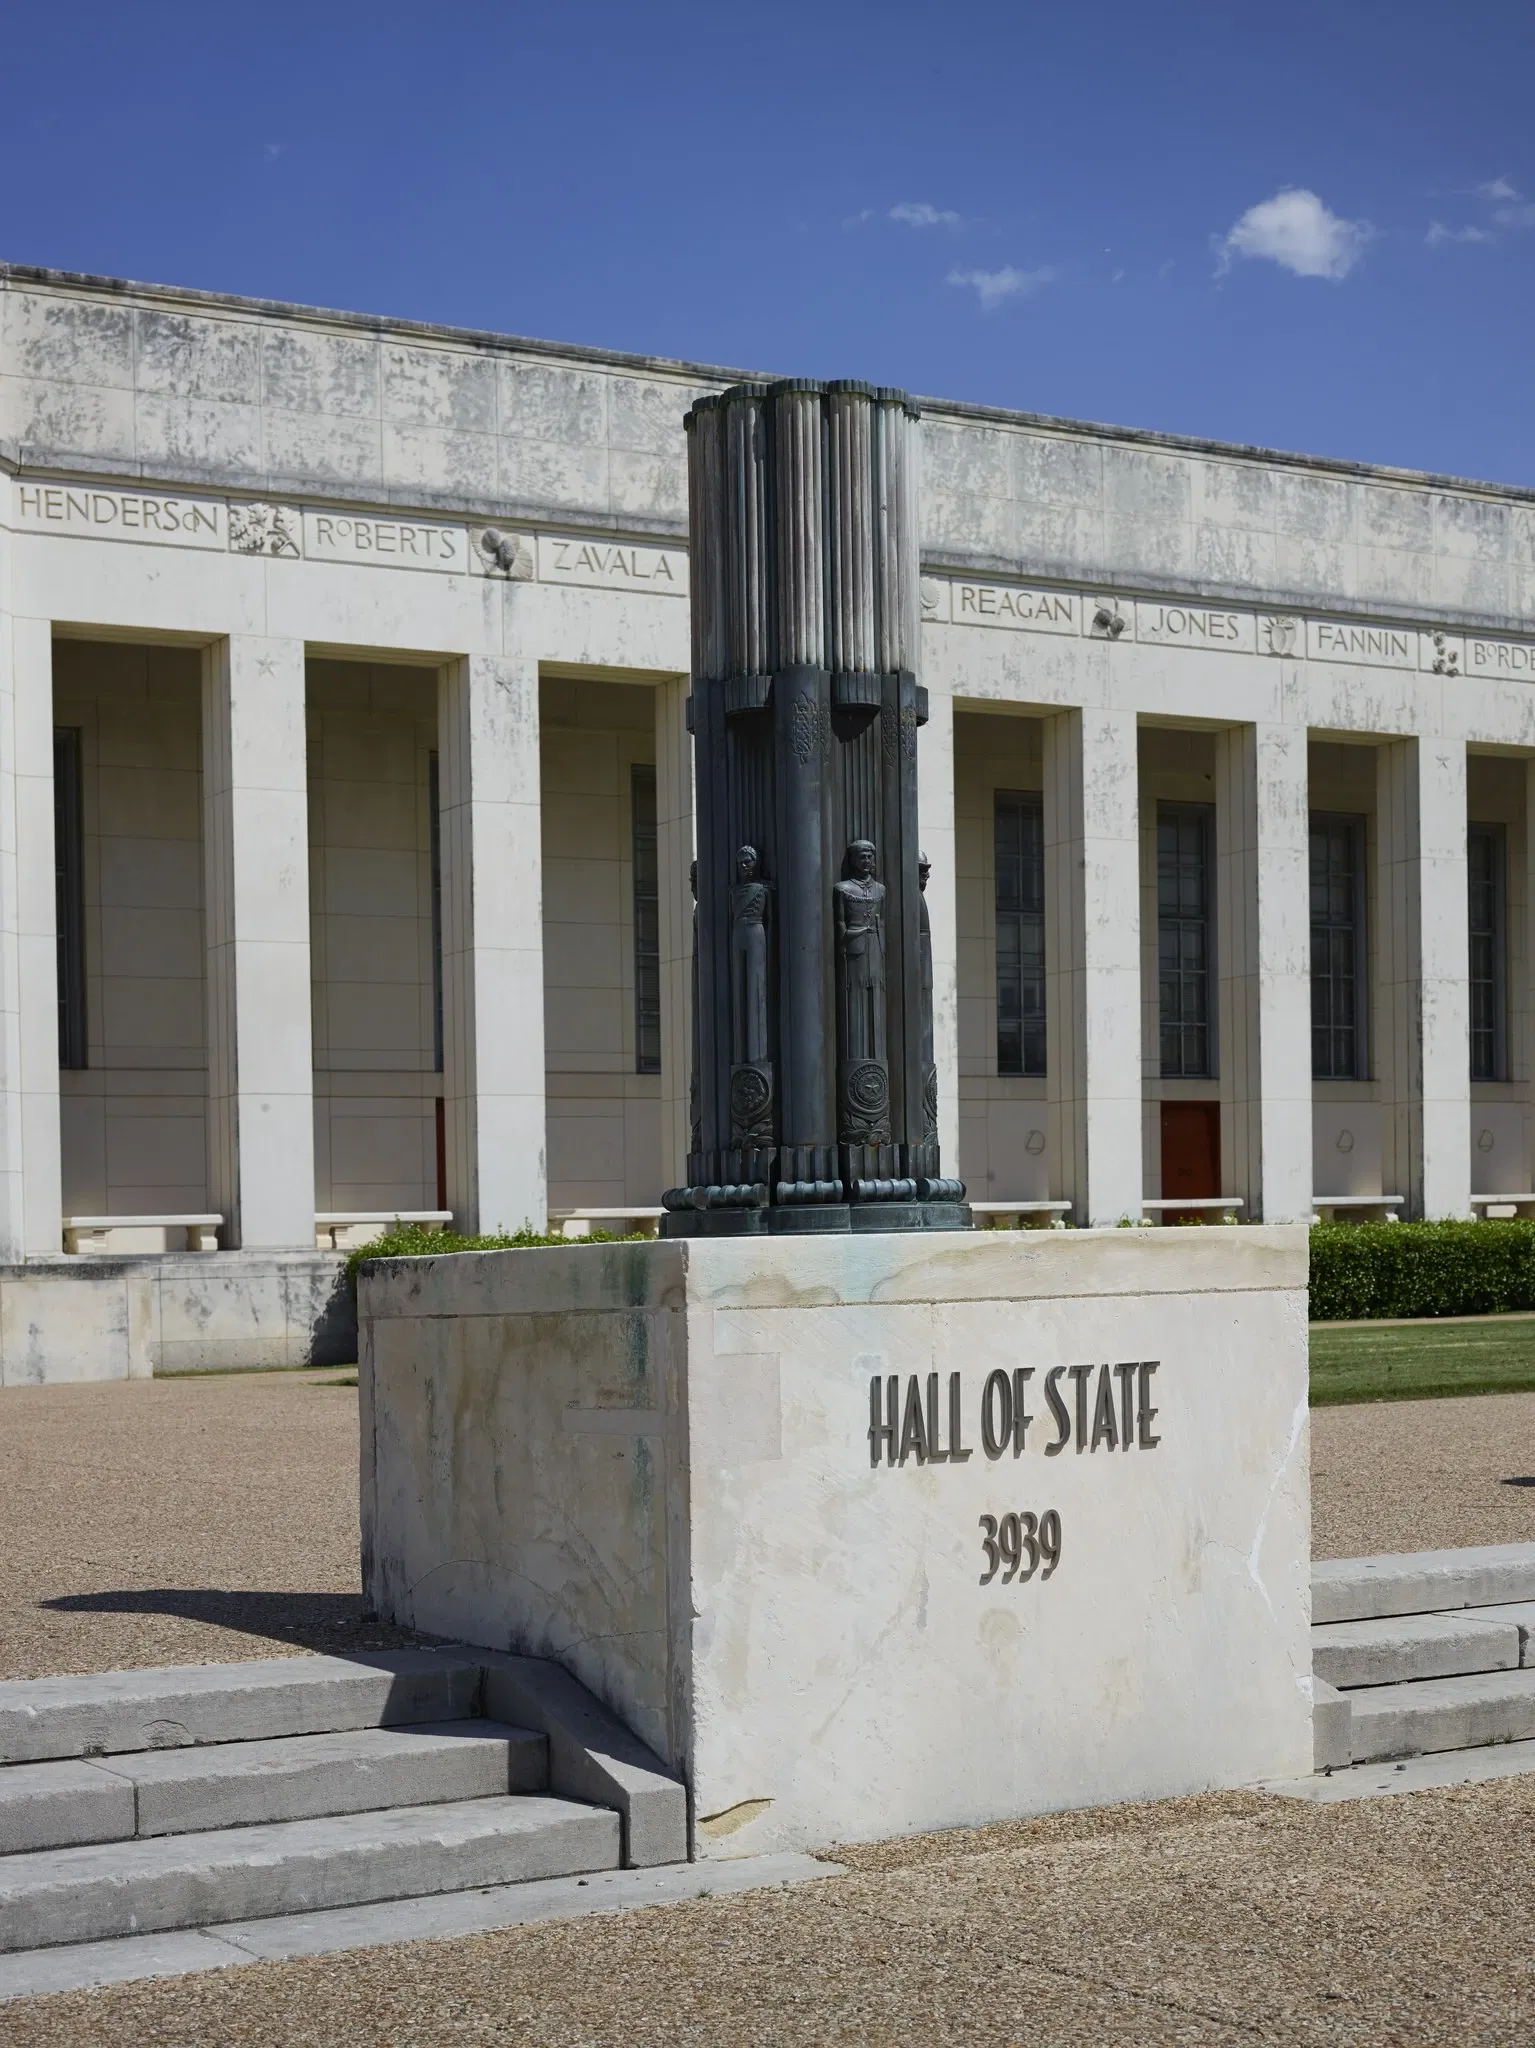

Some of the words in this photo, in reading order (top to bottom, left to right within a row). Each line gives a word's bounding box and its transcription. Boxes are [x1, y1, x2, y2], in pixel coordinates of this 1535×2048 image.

[19, 486, 218, 536] HENDERSON
[316, 517, 456, 559] ROBERTS
[551, 542, 674, 581] ZAVALA
[961, 586, 1073, 622] REAGAN
[1151, 607, 1239, 640] JONES
[1317, 625, 1408, 657] FANNIN
[868, 1371, 973, 1468] HALL
[981, 1367, 1035, 1461] OF
[1044, 1360, 1161, 1457] STATE
[978, 1508, 1062, 1586] 3939
